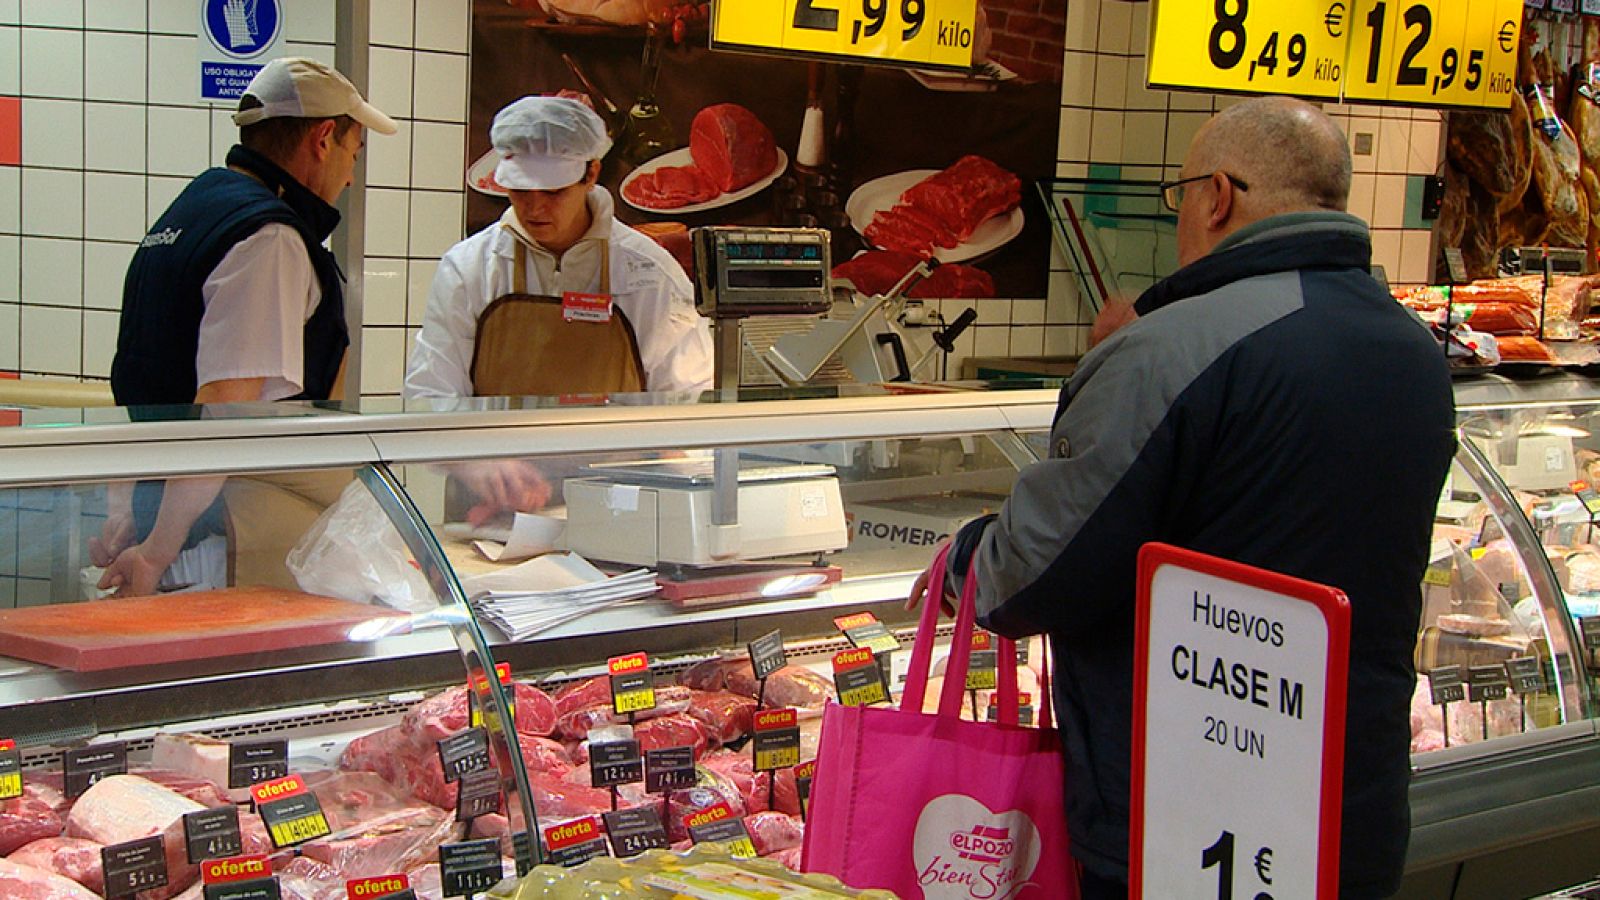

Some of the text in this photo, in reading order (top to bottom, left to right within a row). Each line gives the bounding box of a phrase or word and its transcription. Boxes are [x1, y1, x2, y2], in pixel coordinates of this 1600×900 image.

[1324, 2, 1346, 37] €
[937, 20, 971, 48] kilo
[1208, 0, 1307, 81] 8,49
[1497, 20, 1517, 53] €
[1366, 2, 1483, 95] 12,95
[204, 67, 222, 76] USO
[1313, 58, 1341, 82] kilo
[215, 78, 227, 87] DE
[1488, 72, 1512, 94] kilo
[1193, 590, 1284, 647] Huevos
[612, 656, 643, 672] oferta
[836, 651, 869, 665] oferta
[1171, 644, 1303, 720] CLASE M
[759, 712, 792, 725] oferta
[1204, 715, 1264, 759] 20 UN
[257, 779, 298, 799] oferta
[690, 807, 728, 828] oferta
[551, 821, 592, 842] oferta
[210, 860, 264, 878] oferta
[1254, 847, 1273, 886] €
[354, 879, 403, 896] oferta
